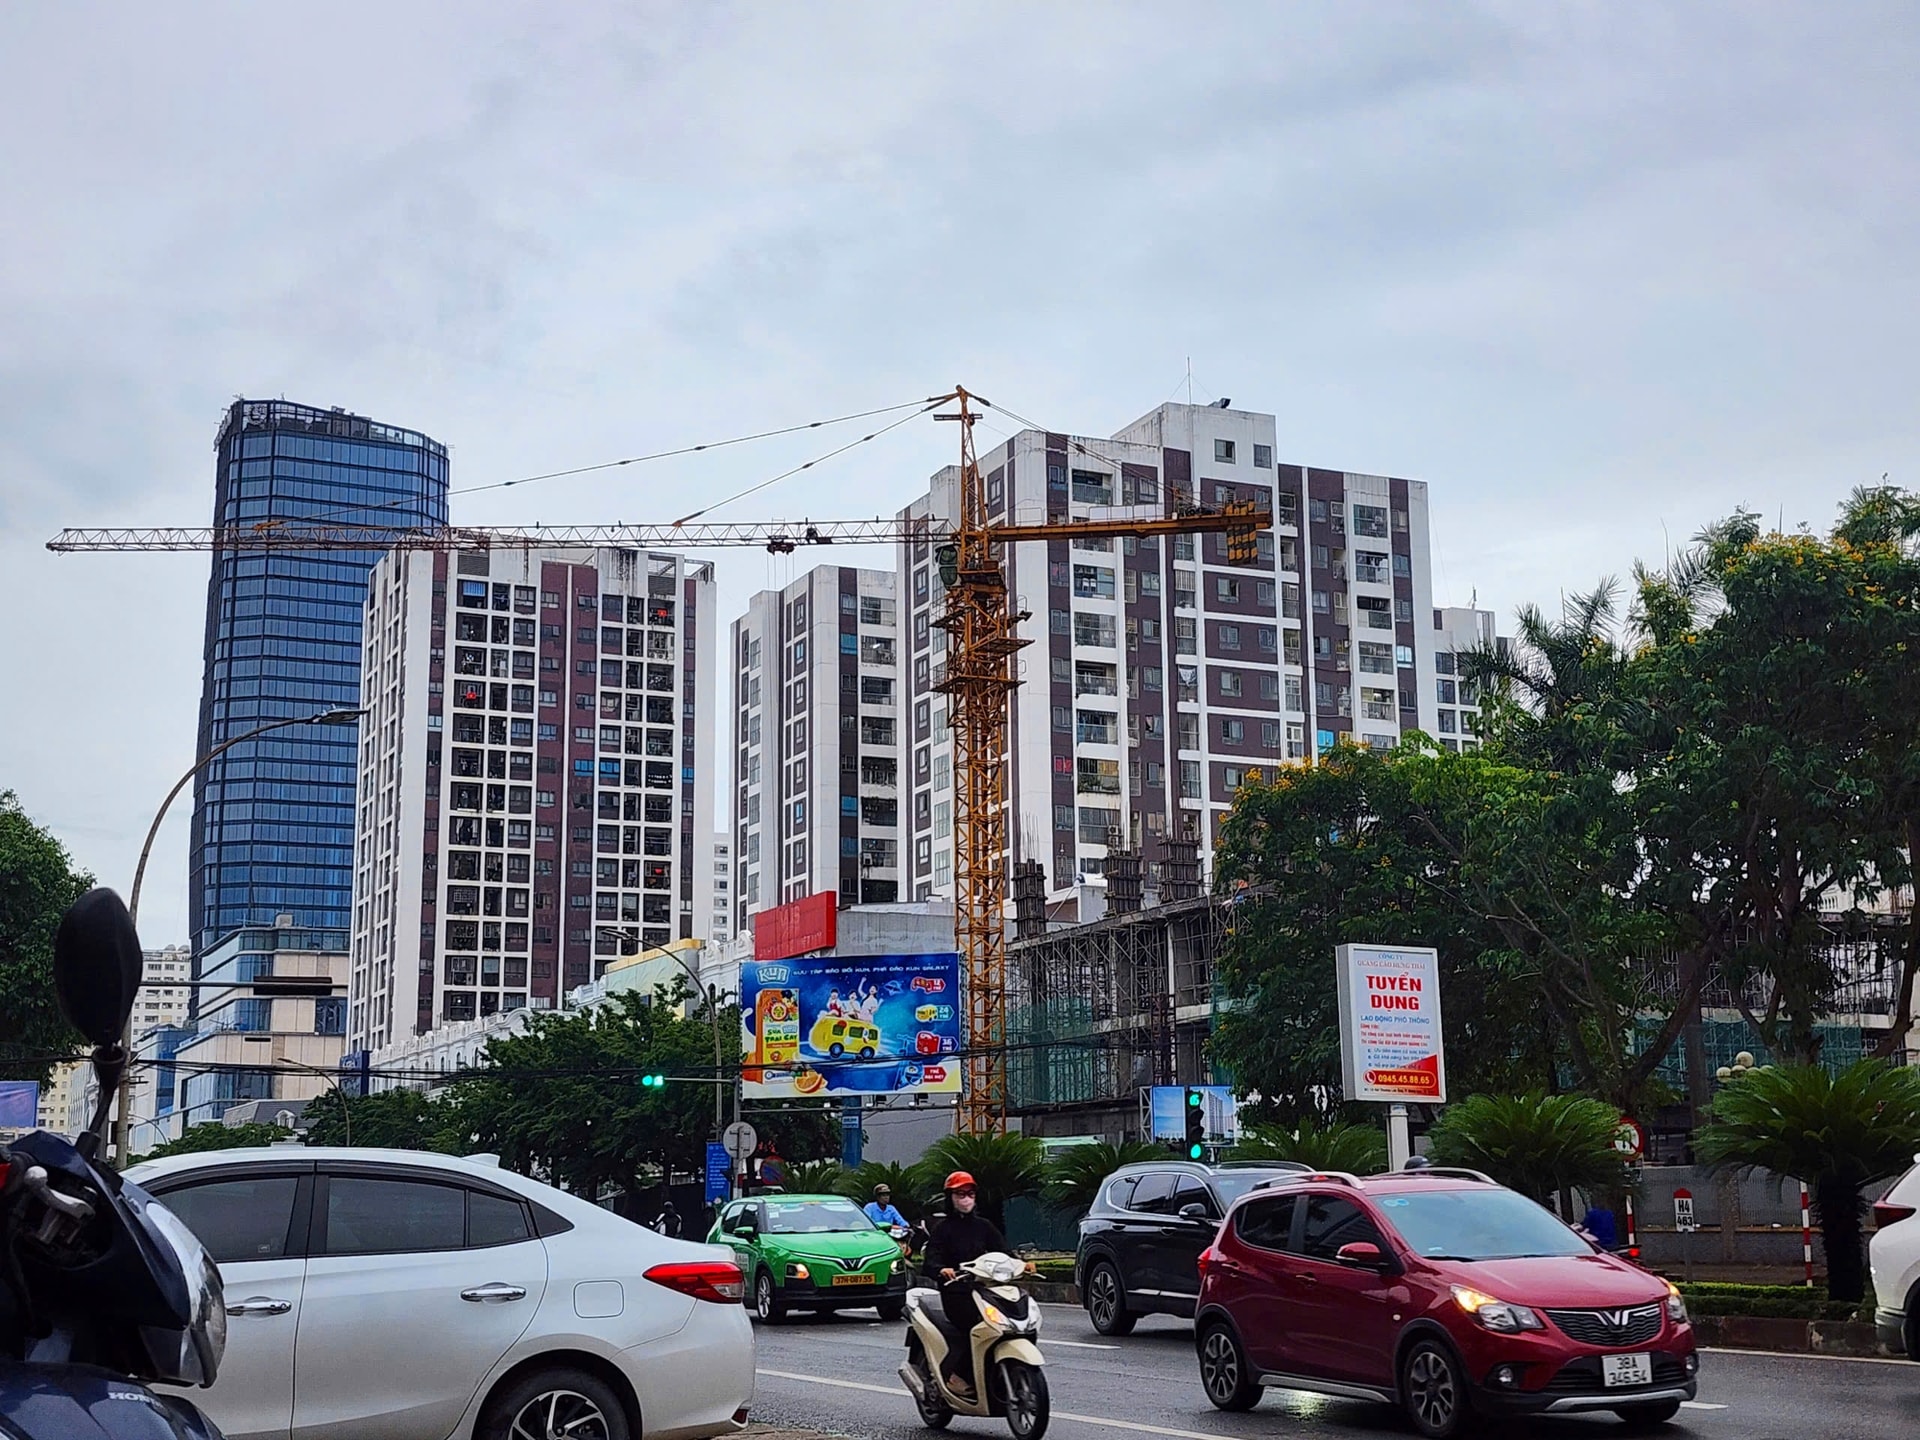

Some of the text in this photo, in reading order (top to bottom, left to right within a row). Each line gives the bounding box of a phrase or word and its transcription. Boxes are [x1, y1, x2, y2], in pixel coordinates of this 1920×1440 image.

[1366, 971, 1422, 992] TUYỂN
[1371, 995, 1420, 1012] DỤNG
[1409, 1016, 1430, 1024] THÔNG
[1678, 1199, 1690, 1212] H4
[1677, 1216, 1693, 1226] 463
[1616, 1357, 1638, 1369] 38A
[1608, 1370, 1647, 1385] 346.54
